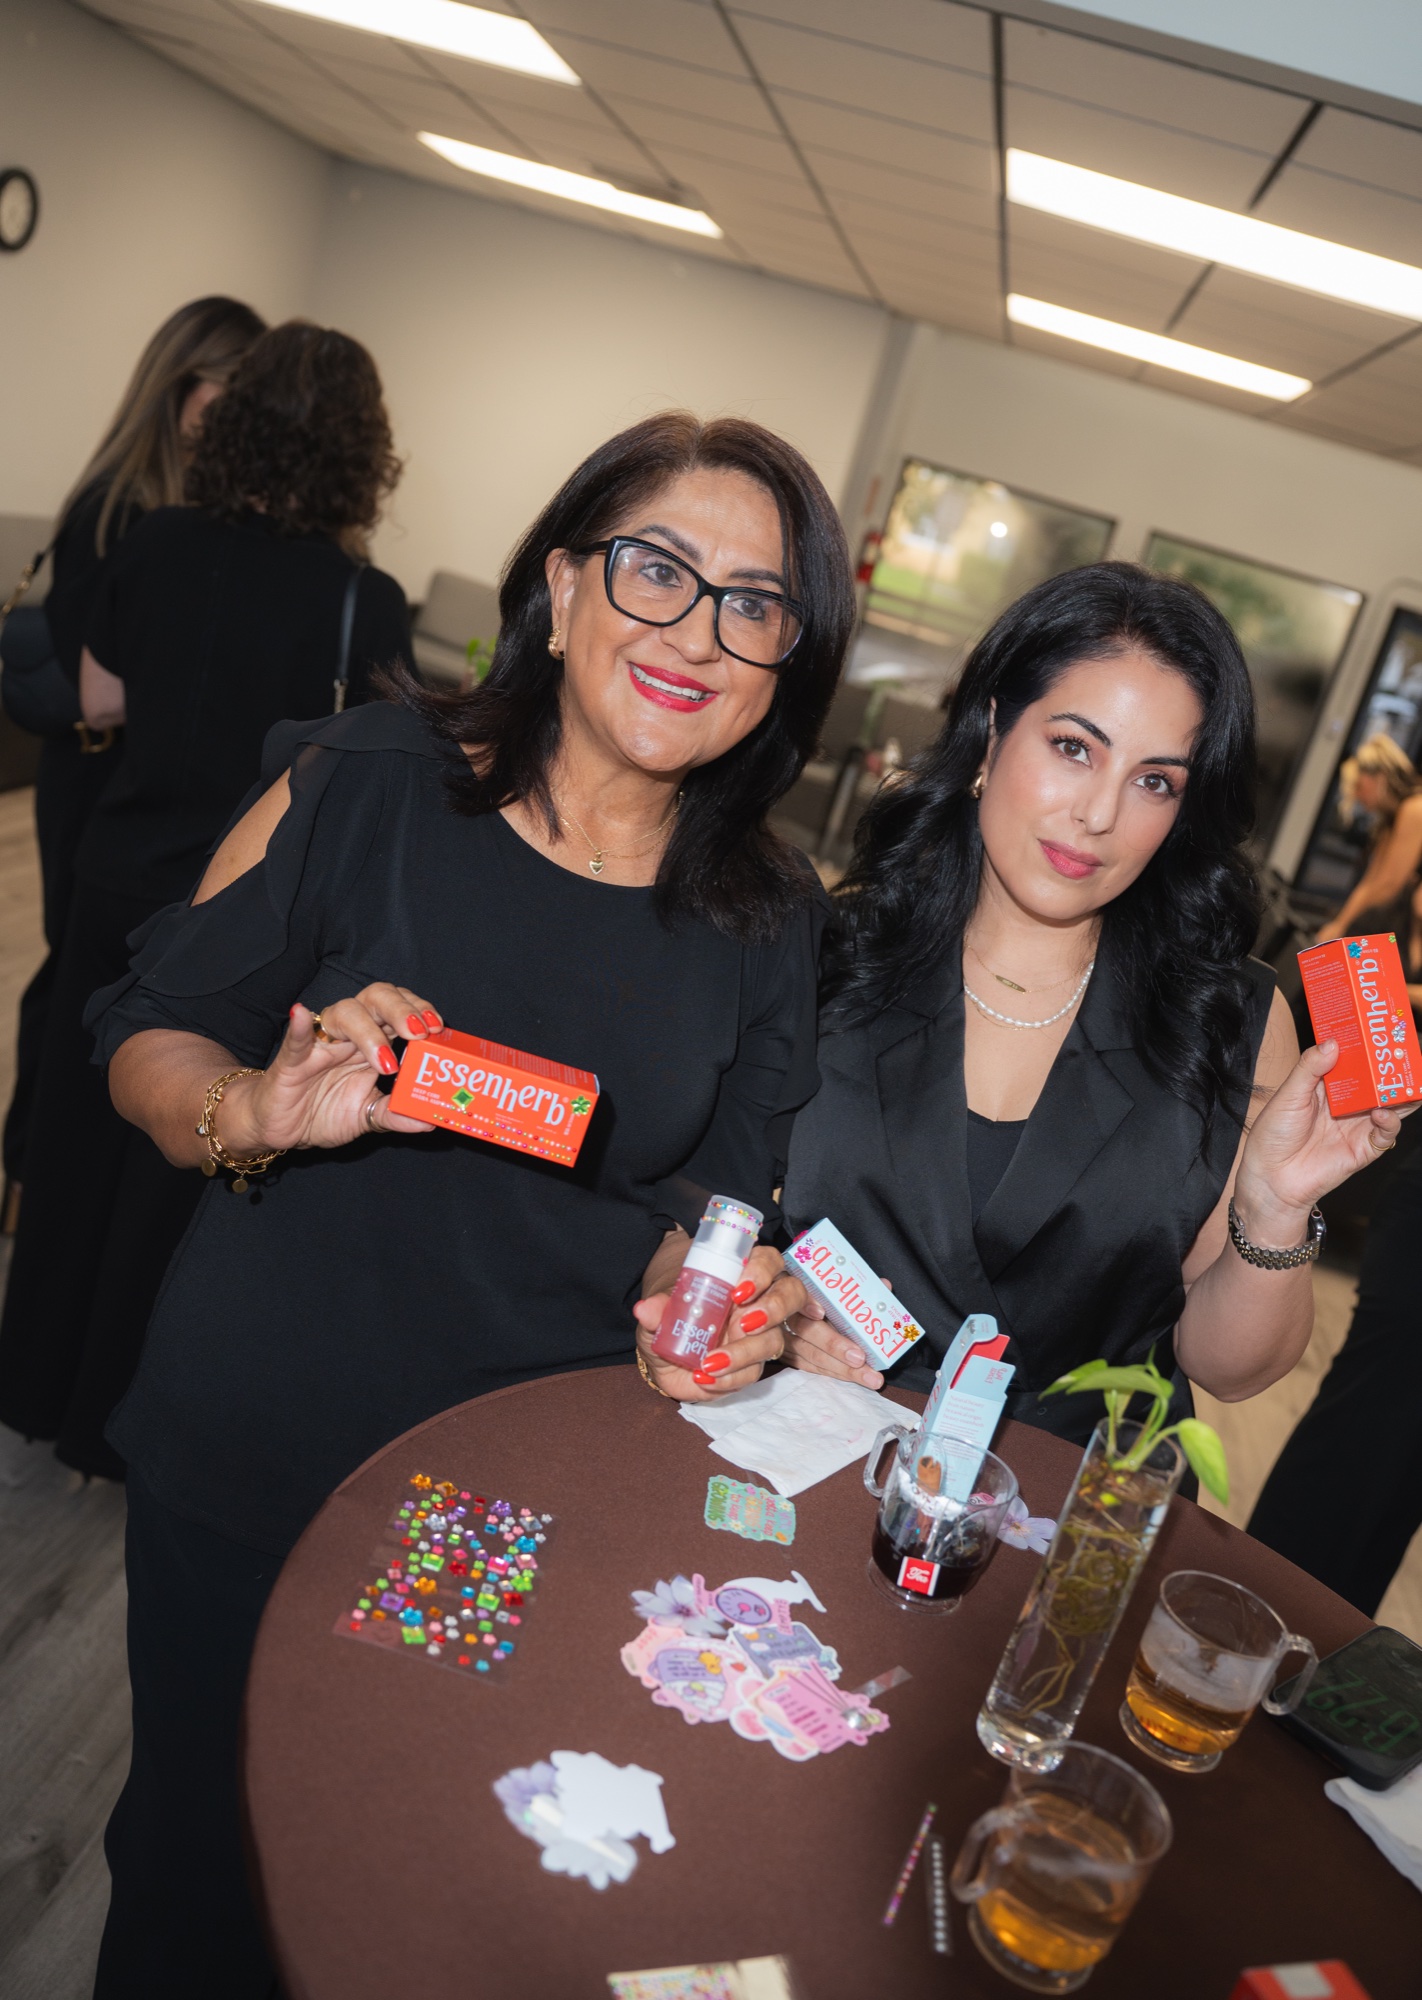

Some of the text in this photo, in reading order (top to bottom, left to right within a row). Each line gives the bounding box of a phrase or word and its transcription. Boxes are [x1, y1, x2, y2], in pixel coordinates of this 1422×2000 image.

[1357, 958, 1404, 1091] Essenherb
[415, 1052, 565, 1126] Essenherb
[671, 1318, 711, 1344] Essen
[810, 1246, 907, 1358] Essenherb
[708, 1482, 729, 1521] GROWING
